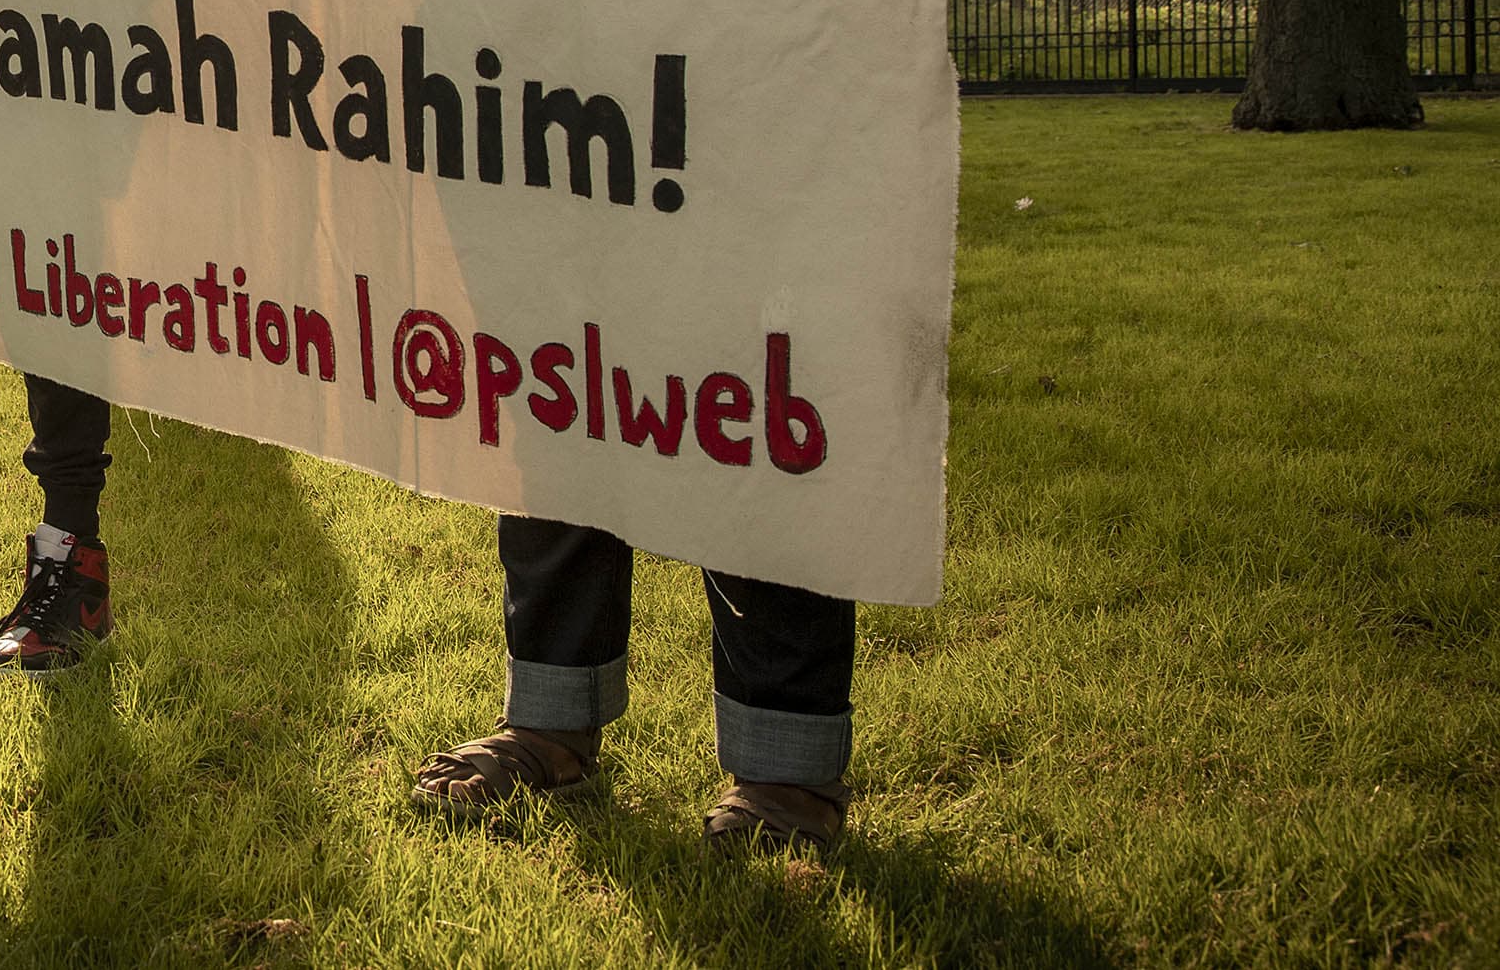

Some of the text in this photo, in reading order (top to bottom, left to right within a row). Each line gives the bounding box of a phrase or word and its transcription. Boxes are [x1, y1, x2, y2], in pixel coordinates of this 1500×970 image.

[267, 9, 688, 213] Rahim!
[10, 228, 336, 383] Liberation
[392, 308, 828, 474] @pslweb
